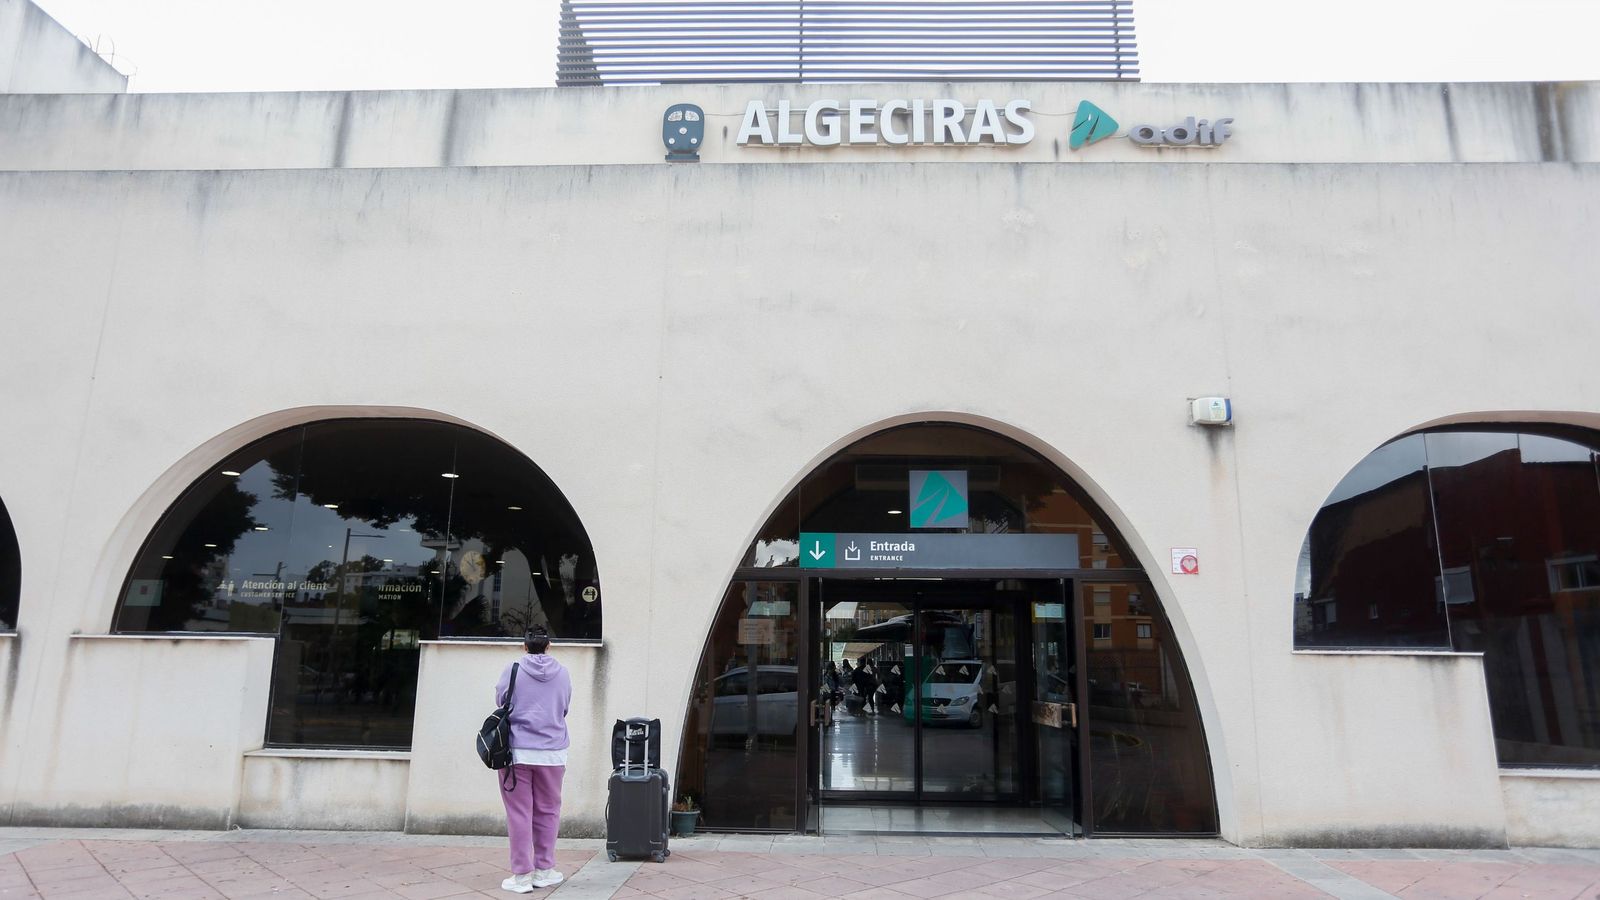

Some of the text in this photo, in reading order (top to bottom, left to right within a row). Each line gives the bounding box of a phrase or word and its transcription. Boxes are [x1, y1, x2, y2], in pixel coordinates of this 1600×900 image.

[737, 99, 1034, 147] ALGECIRAS
[1129, 116, 1234, 148] adif
[870, 541, 915, 552] Entrada
[242, 579, 284, 590] Atención
[287, 580, 296, 590] al
